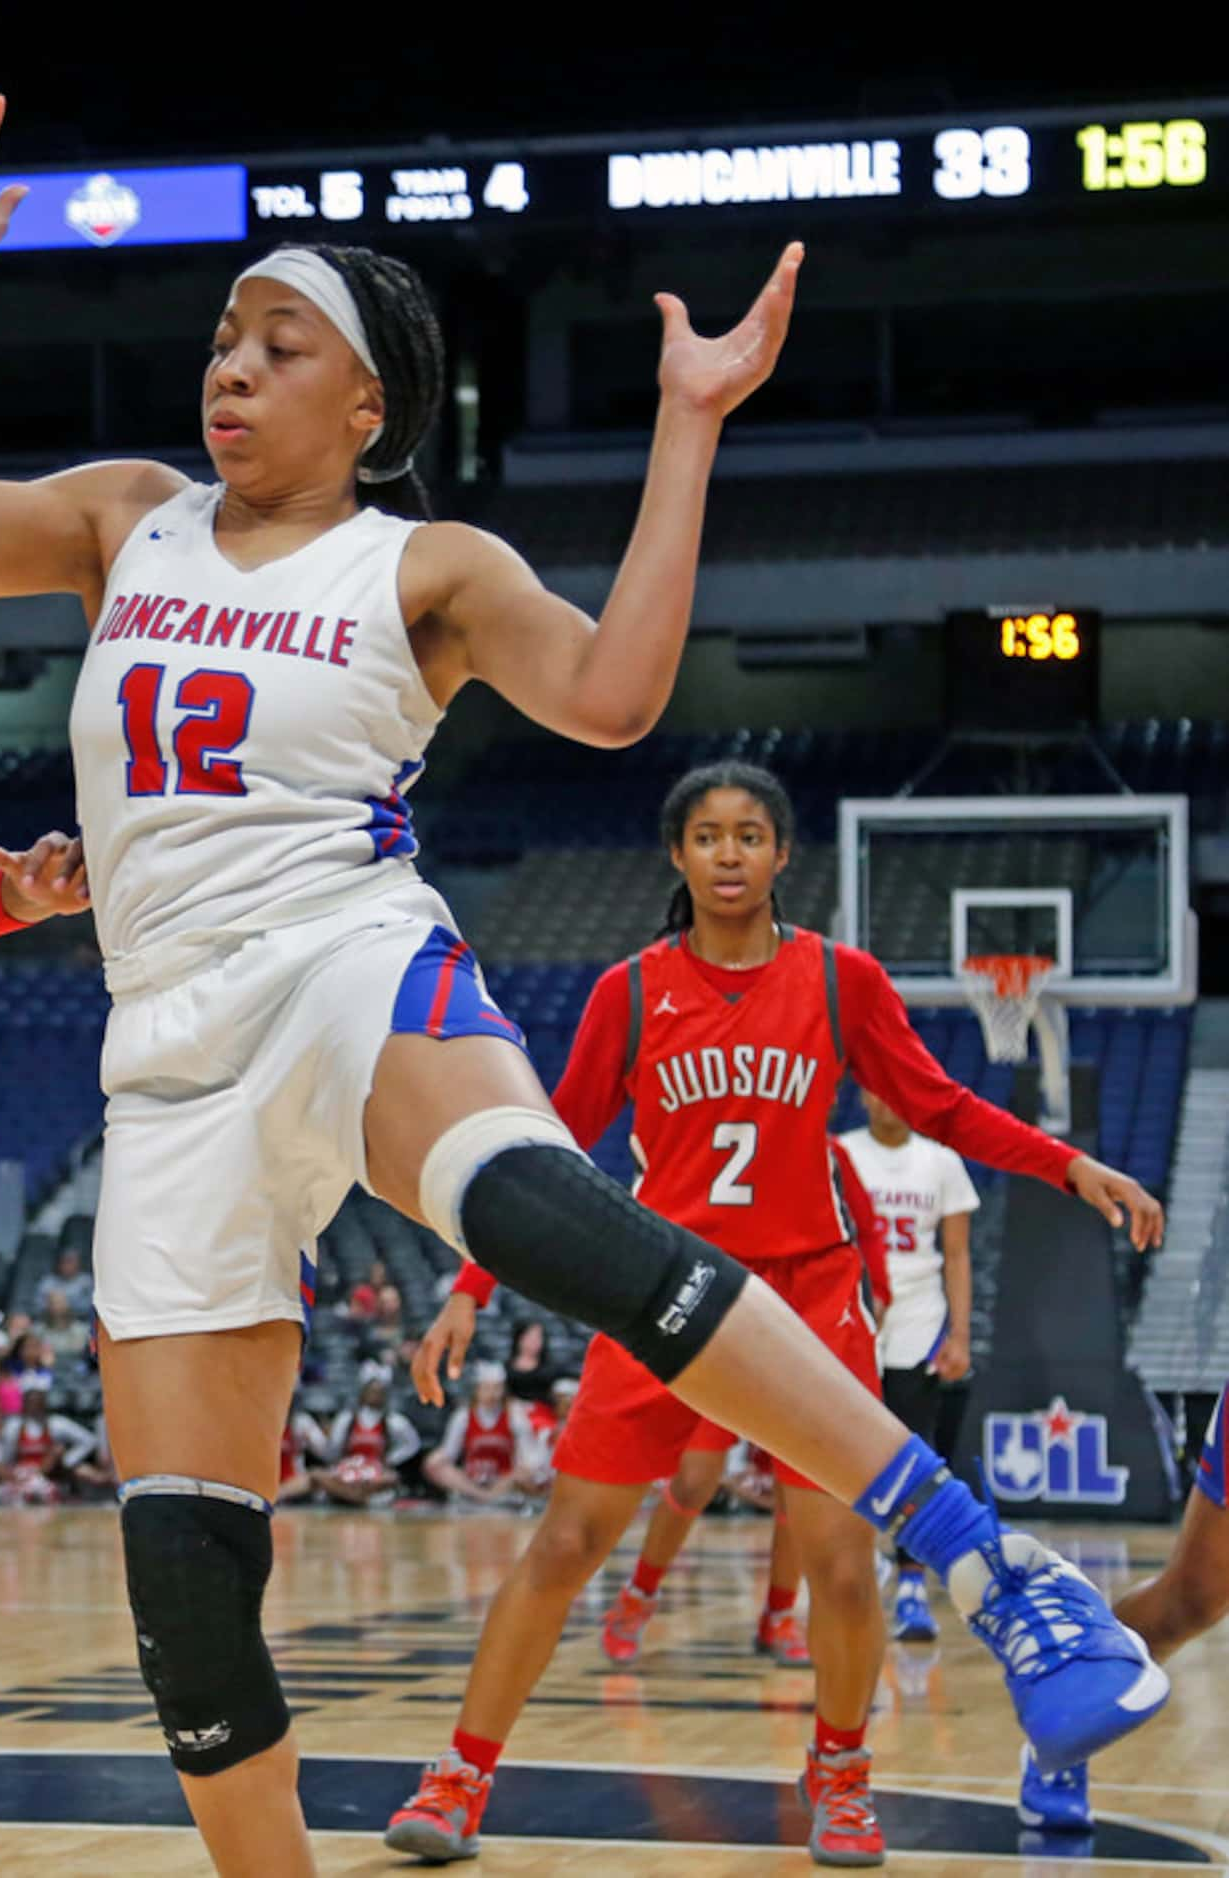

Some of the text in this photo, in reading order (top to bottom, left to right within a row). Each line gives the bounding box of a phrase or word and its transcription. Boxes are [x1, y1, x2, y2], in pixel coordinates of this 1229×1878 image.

[319, 171, 364, 221] 5
[483, 162, 529, 213] 4
[607, 120, 1207, 209] DUNCANVILLE 33 1:56
[96, 593, 358, 668] DUNCANVILLE
[1001, 612, 1080, 661] 1:56
[116, 662, 256, 797] 12
[655, 1044, 818, 1114] JUDSON
[707, 1121, 759, 1207] 2
[983, 1396, 1131, 1505] UIL
